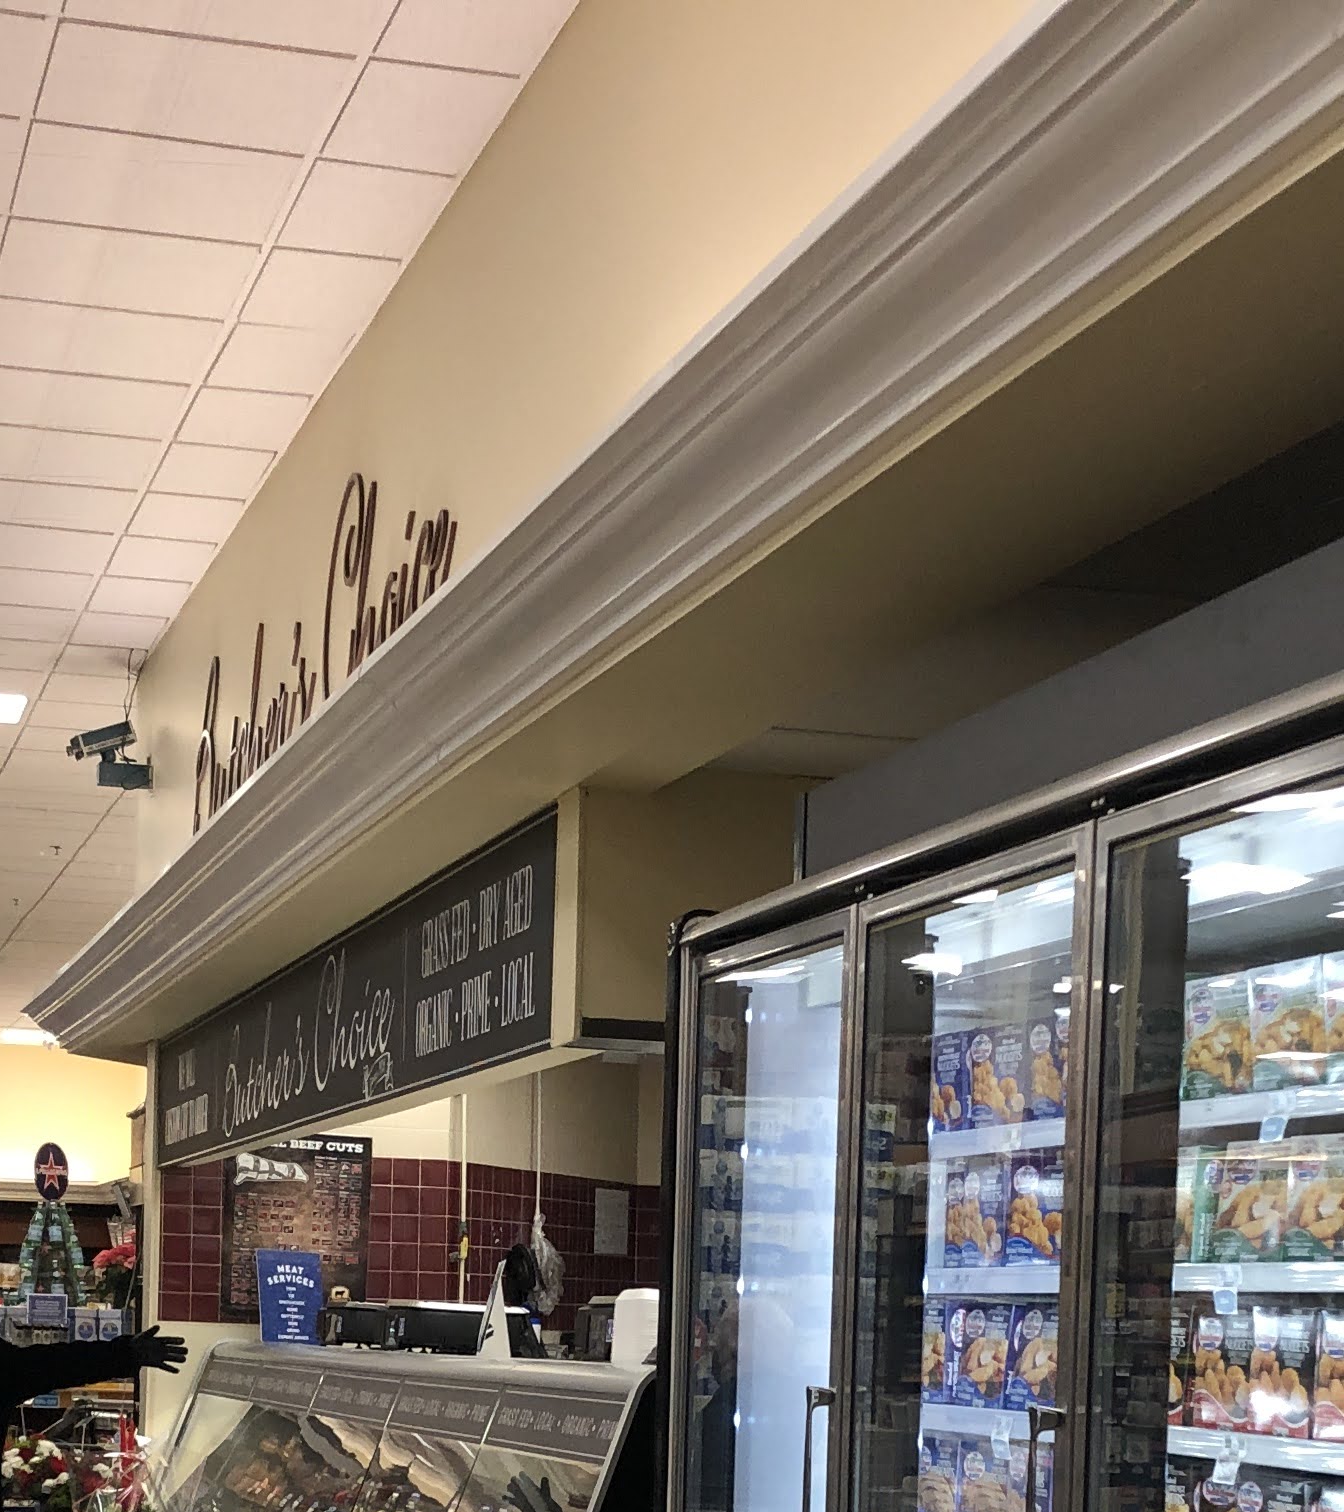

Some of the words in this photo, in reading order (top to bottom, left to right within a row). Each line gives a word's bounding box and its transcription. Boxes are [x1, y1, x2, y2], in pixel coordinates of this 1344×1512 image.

[422, 909, 450, 978] GRASS
[450, 899, 470, 964] FED
[479, 880, 501, 951] DRY
[503, 864, 533, 941] AGED
[415, 988, 453, 1058] ORGANIC
[460, 970, 492, 1041] PRIME
[501, 951, 536, 1028] LOCAL
[222, 1001, 309, 1137] Butcher's
[314, 948, 395, 1092] Choice
[290, 1139, 324, 1152] BEEF
[326, 1142, 364, 1154] CUTS
[267, 1274, 315, 1288] SERVICES
[277, 1265, 304, 1275] MEAT
